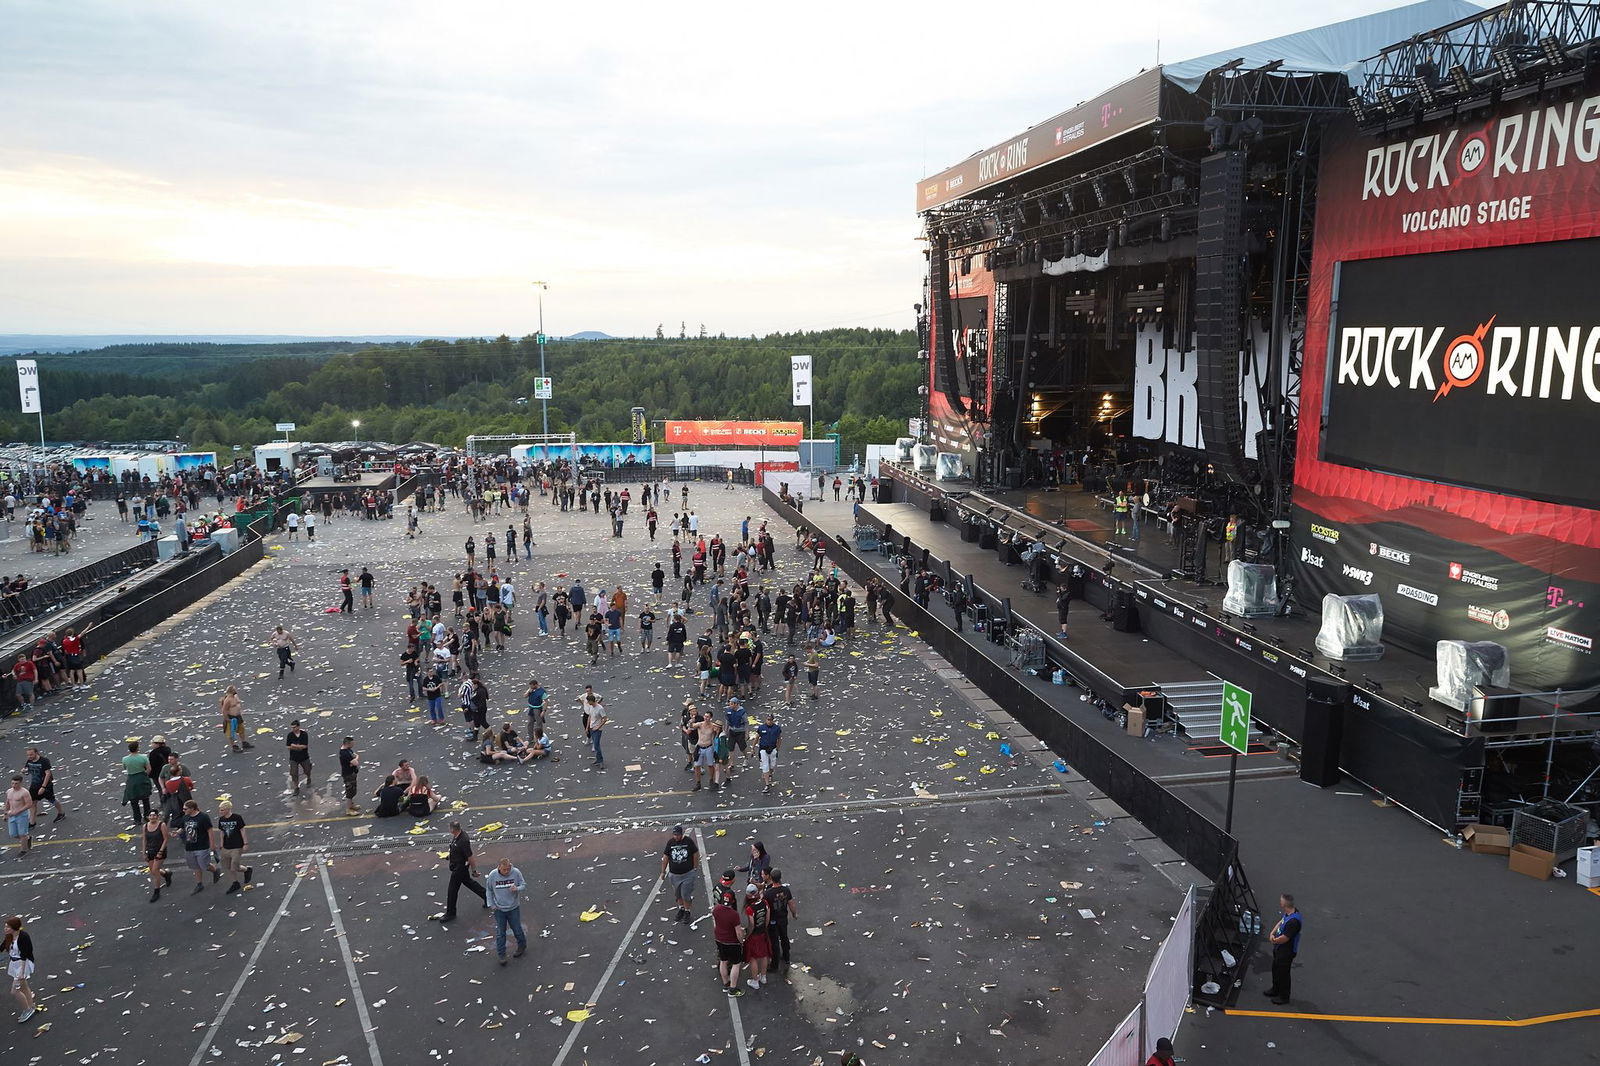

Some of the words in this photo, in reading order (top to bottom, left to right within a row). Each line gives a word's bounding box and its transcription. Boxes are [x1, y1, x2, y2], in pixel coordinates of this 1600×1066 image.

[1362, 129, 1459, 201] ROCK
[1462, 144, 1482, 164] AM
[1492, 95, 1600, 178] RING
[979, 151, 1000, 182] ROCK
[1007, 138, 1029, 171] RING
[1402, 204, 1471, 234] VOLCANO
[1476, 195, 1532, 224] STAGE
[1337, 326, 1446, 391] ROCK
[1452, 352, 1474, 369] AM
[1486, 325, 1600, 404] RING
[1311, 523, 1339, 540] ROCKSTAR
[1379, 547, 1411, 564] BECK'S
[1461, 575, 1499, 591] STRAUSS
[1462, 570, 1499, 584] ENGELBERT
[1549, 629, 1564, 639] LIVE
[1564, 634, 1590, 646] NATION
